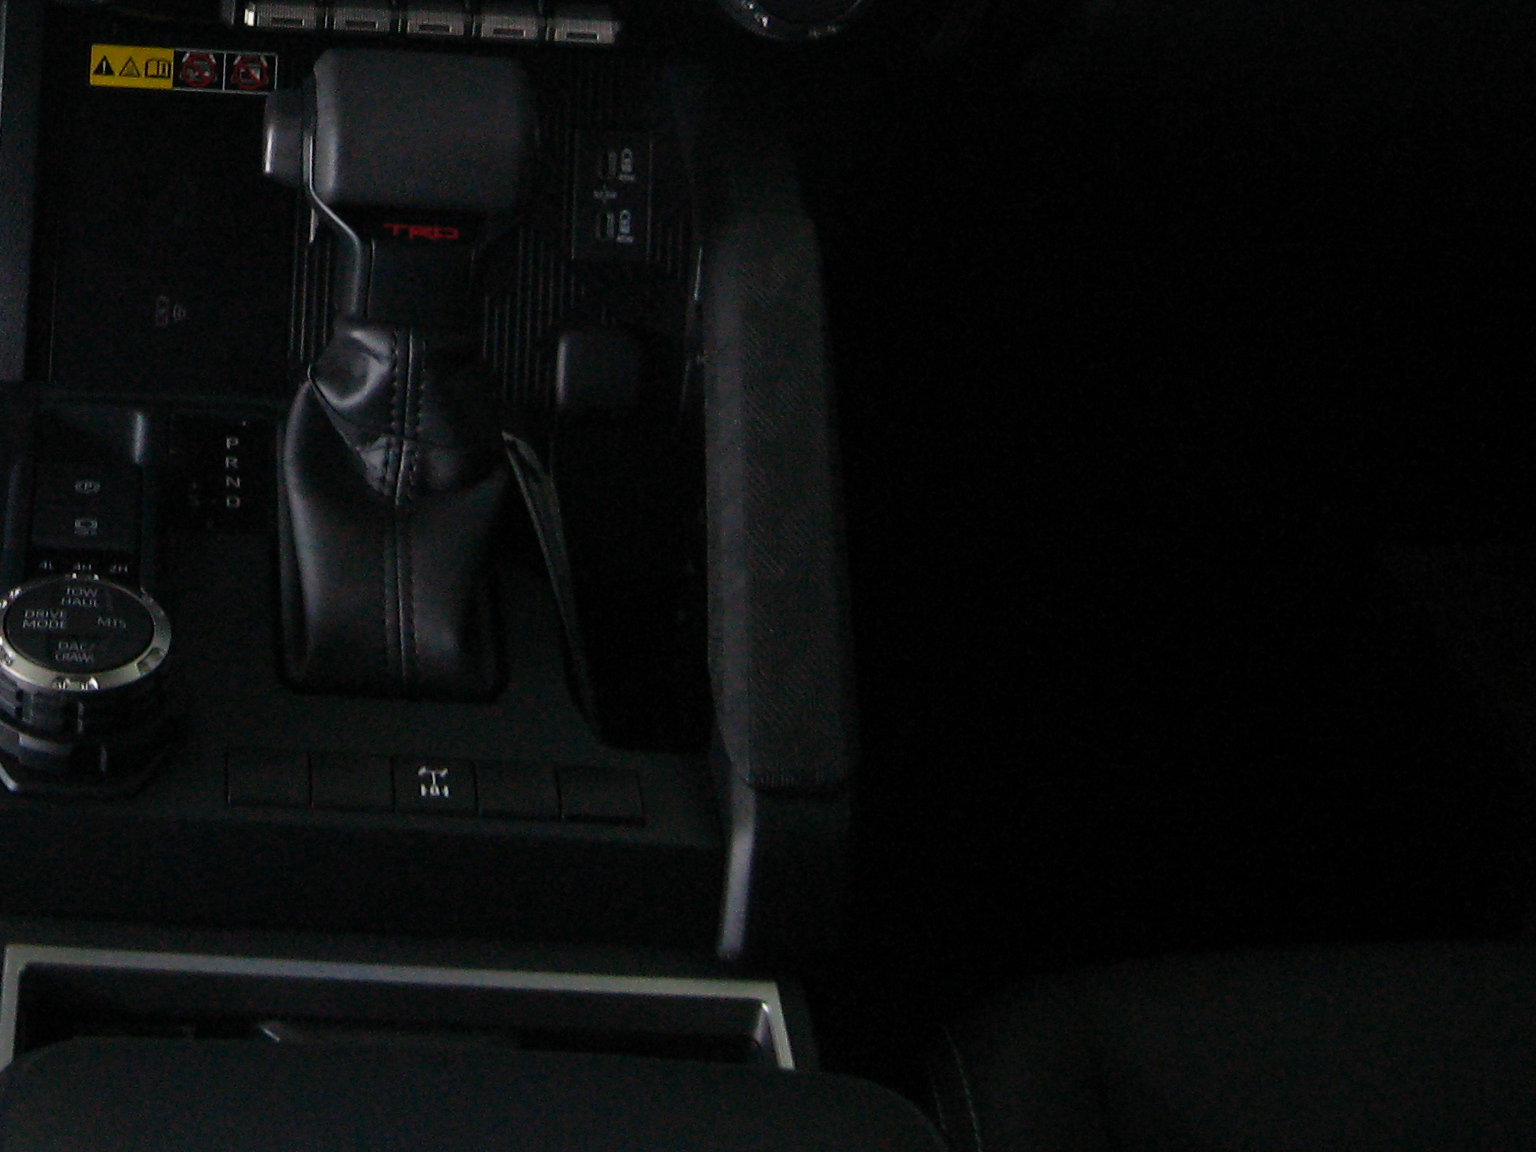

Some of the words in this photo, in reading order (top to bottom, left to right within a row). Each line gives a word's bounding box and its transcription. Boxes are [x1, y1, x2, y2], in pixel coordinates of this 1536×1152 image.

[383, 222, 460, 241] TRD
[225, 435, 240, 450] P
[225, 456, 239, 470] R
[225, 475, 241, 489] N
[226, 495, 241, 509] D
[60, 597, 99, 608] HAUL
[24, 608, 67, 619] DRIVE
[22, 619, 67, 630] MODE
